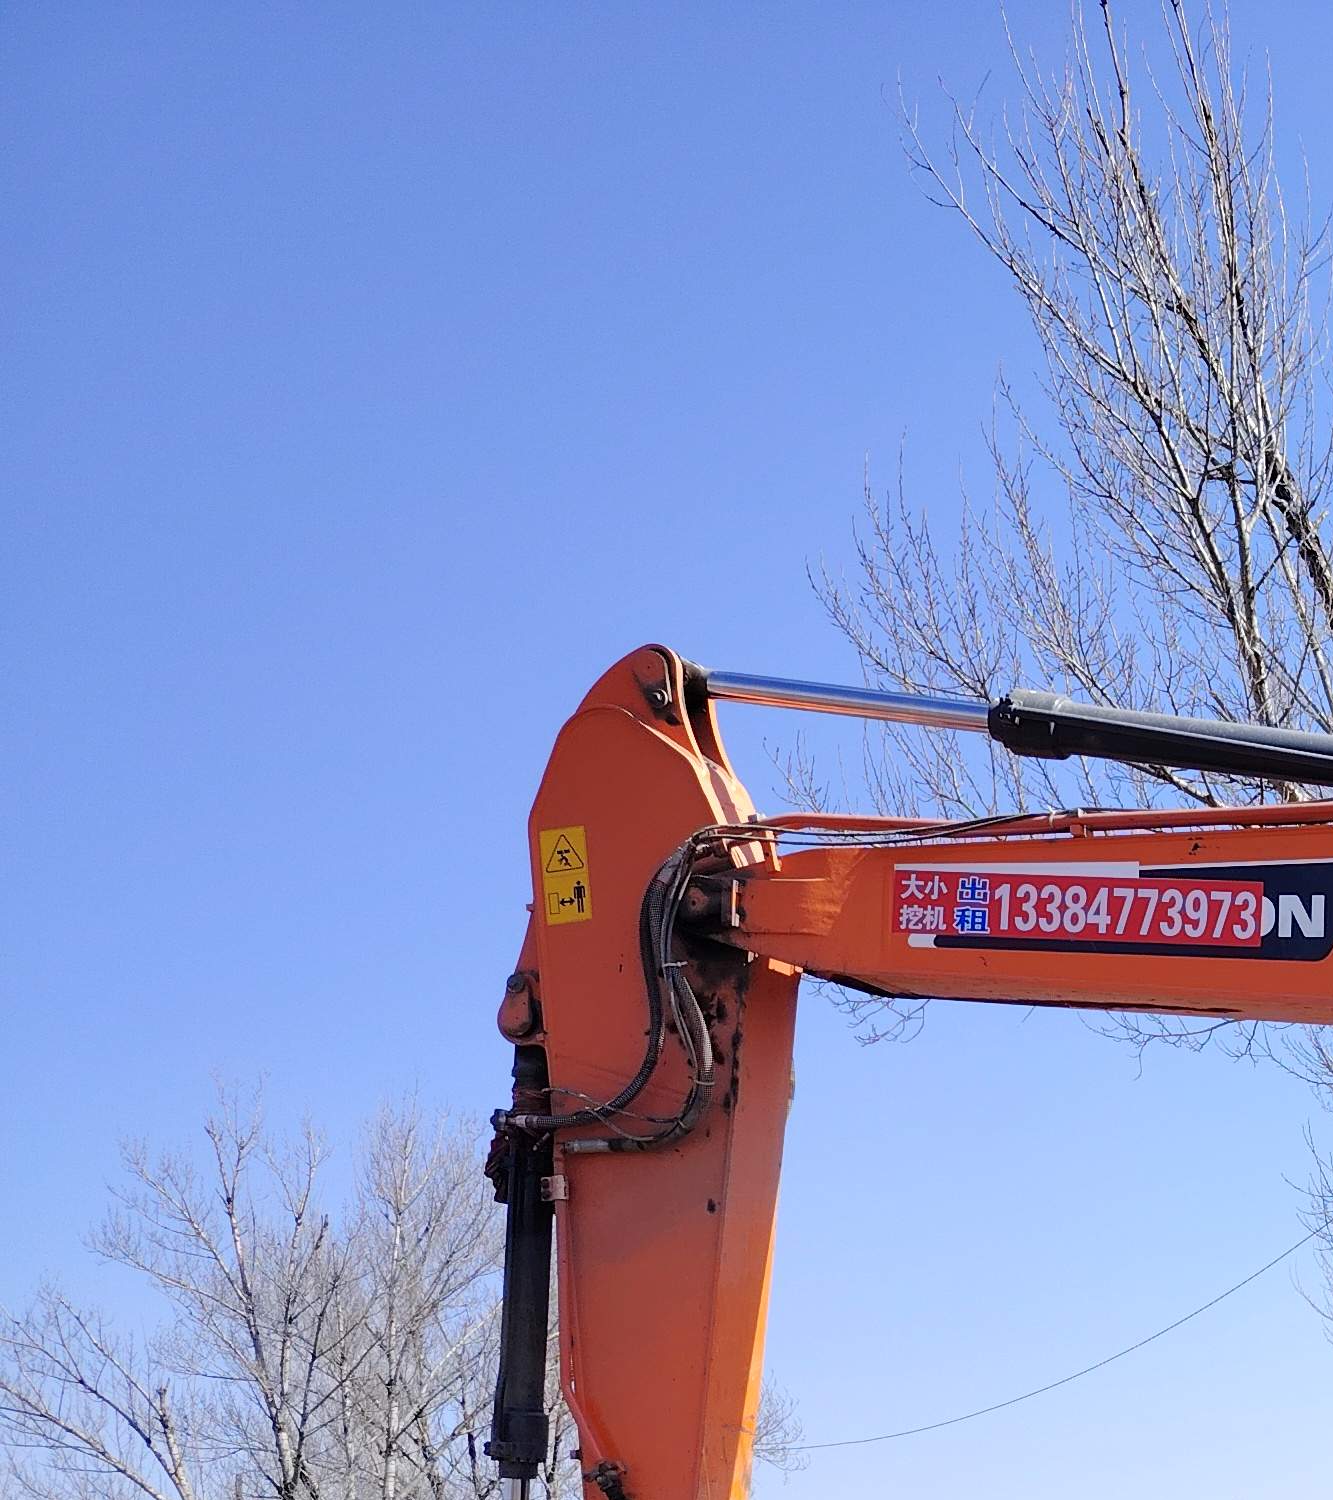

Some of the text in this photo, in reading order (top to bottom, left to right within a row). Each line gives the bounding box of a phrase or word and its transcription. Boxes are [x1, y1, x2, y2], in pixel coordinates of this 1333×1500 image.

[900, 873, 948, 901] 大小
[953, 876, 991, 935] 出租
[899, 904, 947, 931] 挖机
[995, 882, 1258, 940] 13384773973
